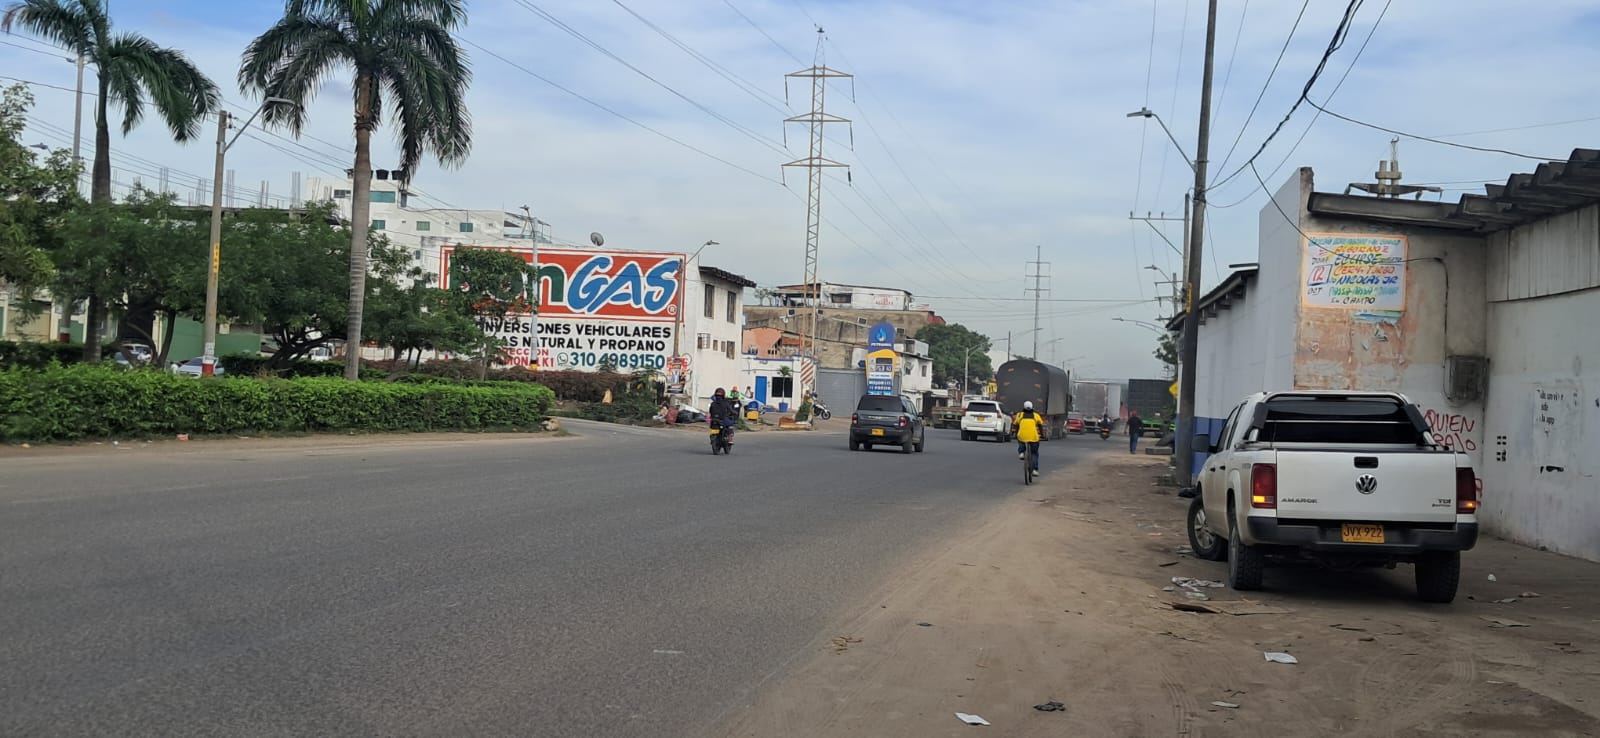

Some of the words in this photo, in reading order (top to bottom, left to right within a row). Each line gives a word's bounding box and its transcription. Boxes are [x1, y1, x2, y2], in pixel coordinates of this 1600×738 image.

[1312, 266, 1325, 282] 12
[1382, 275, 1398, 284] JR
[575, 324, 671, 338] VEHICULARES
[587, 338, 597, 350] Y
[599, 339, 666, 352] PROPANO
[569, 351, 597, 367] 310
[597, 352, 666, 369] 4989150
[1423, 409, 1475, 434] QUIEN
[1280, 496, 1318, 504] AMAROK
